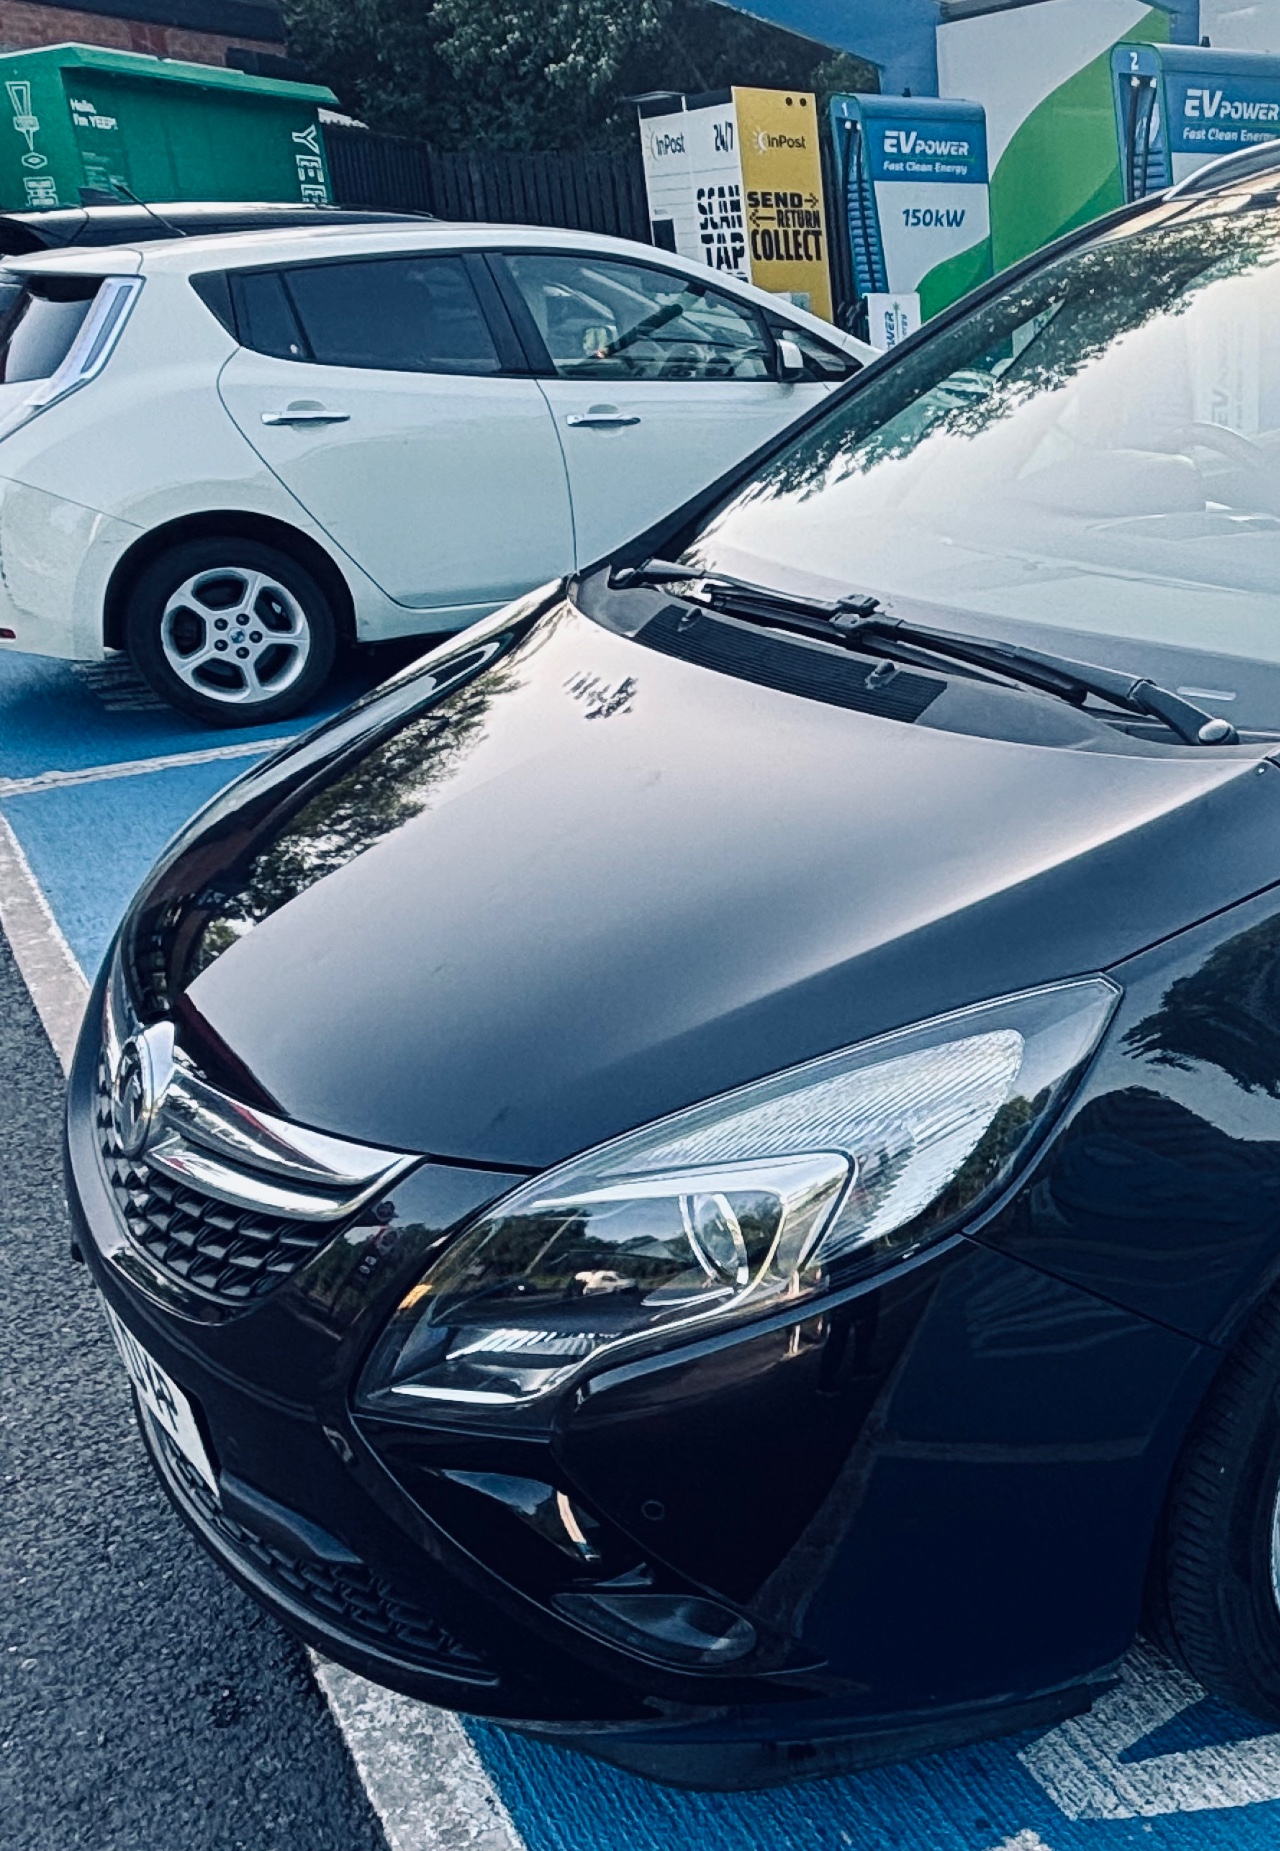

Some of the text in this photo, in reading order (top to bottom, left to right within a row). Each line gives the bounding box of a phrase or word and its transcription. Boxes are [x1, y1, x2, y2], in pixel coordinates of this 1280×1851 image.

[1129, 52, 1139, 70] 2
[841, 102, 848, 117] 1
[767, 134, 806, 149] InPost
[1183, 127, 1205, 140] Fast
[1208, 128, 1238, 141] Clean
[656, 131, 686, 156] InPost
[883, 161, 968, 175] Fast Clean Energy
[747, 191, 803, 209] SEND
[776, 209, 821, 229] RETURN
[902, 208, 966, 227] 150kW
[750, 229, 823, 262] COLLECT
